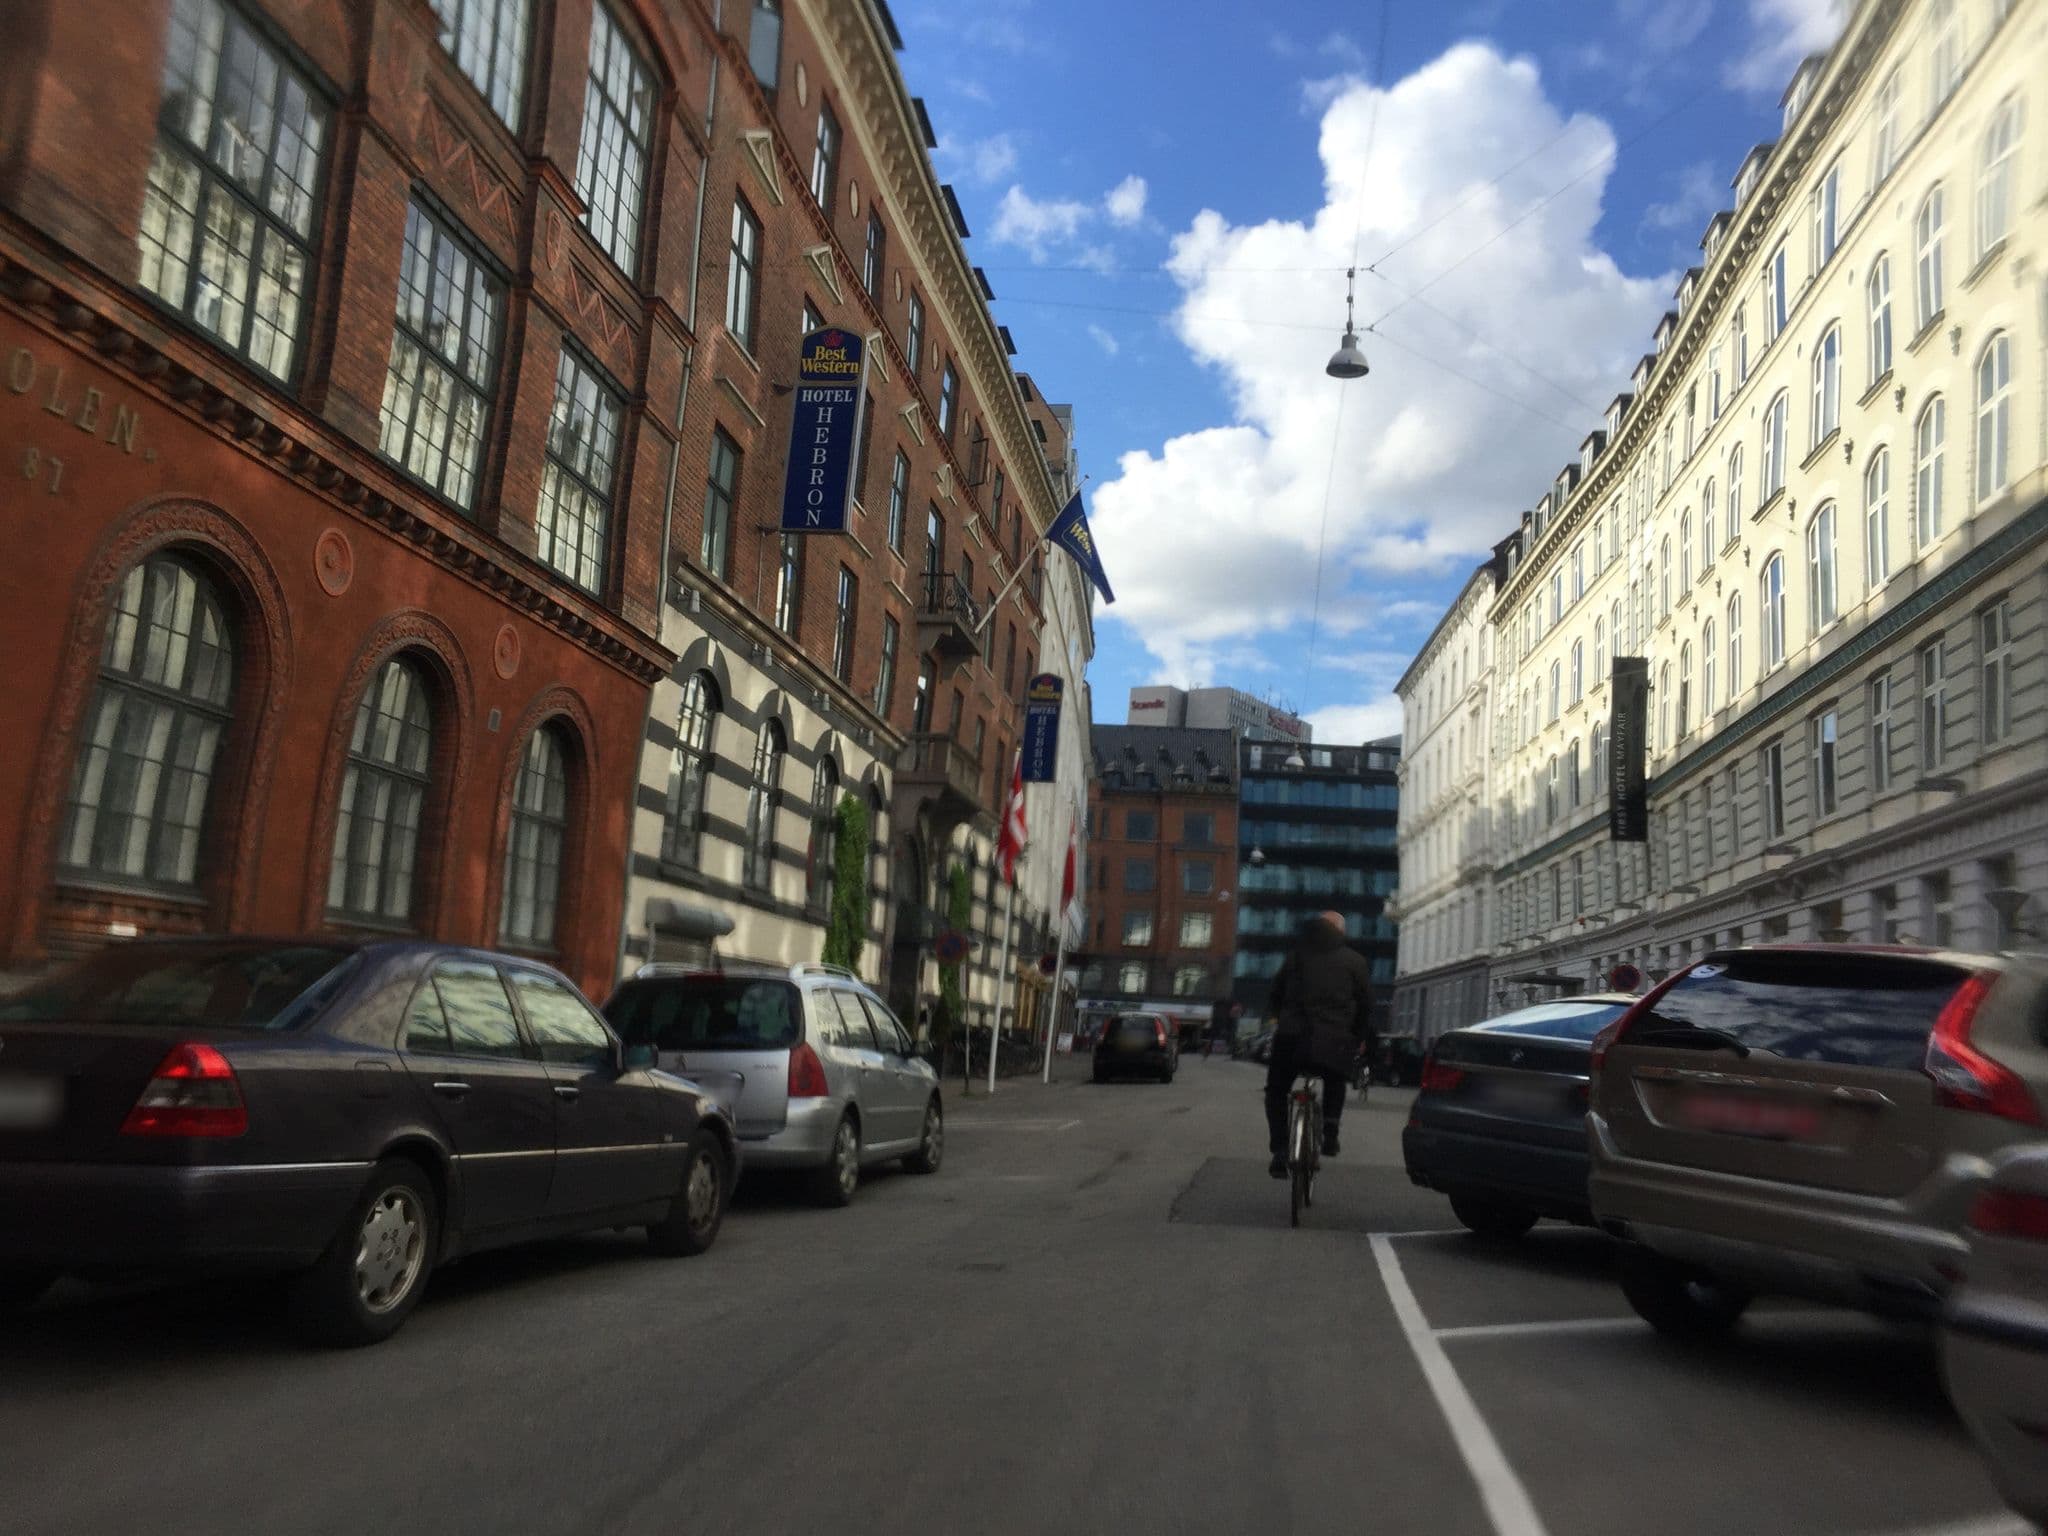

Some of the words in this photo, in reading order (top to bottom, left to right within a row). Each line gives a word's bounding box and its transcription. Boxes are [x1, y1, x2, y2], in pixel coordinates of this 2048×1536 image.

[815, 345, 847, 361] Best
[801, 358, 861, 375] Western
[802, 389, 854, 403] HOTEL
[805, 406, 834, 527] HEBRON
[1616, 712, 1626, 760] MAYFAIR
[1616, 765, 1626, 800] HOTEL
